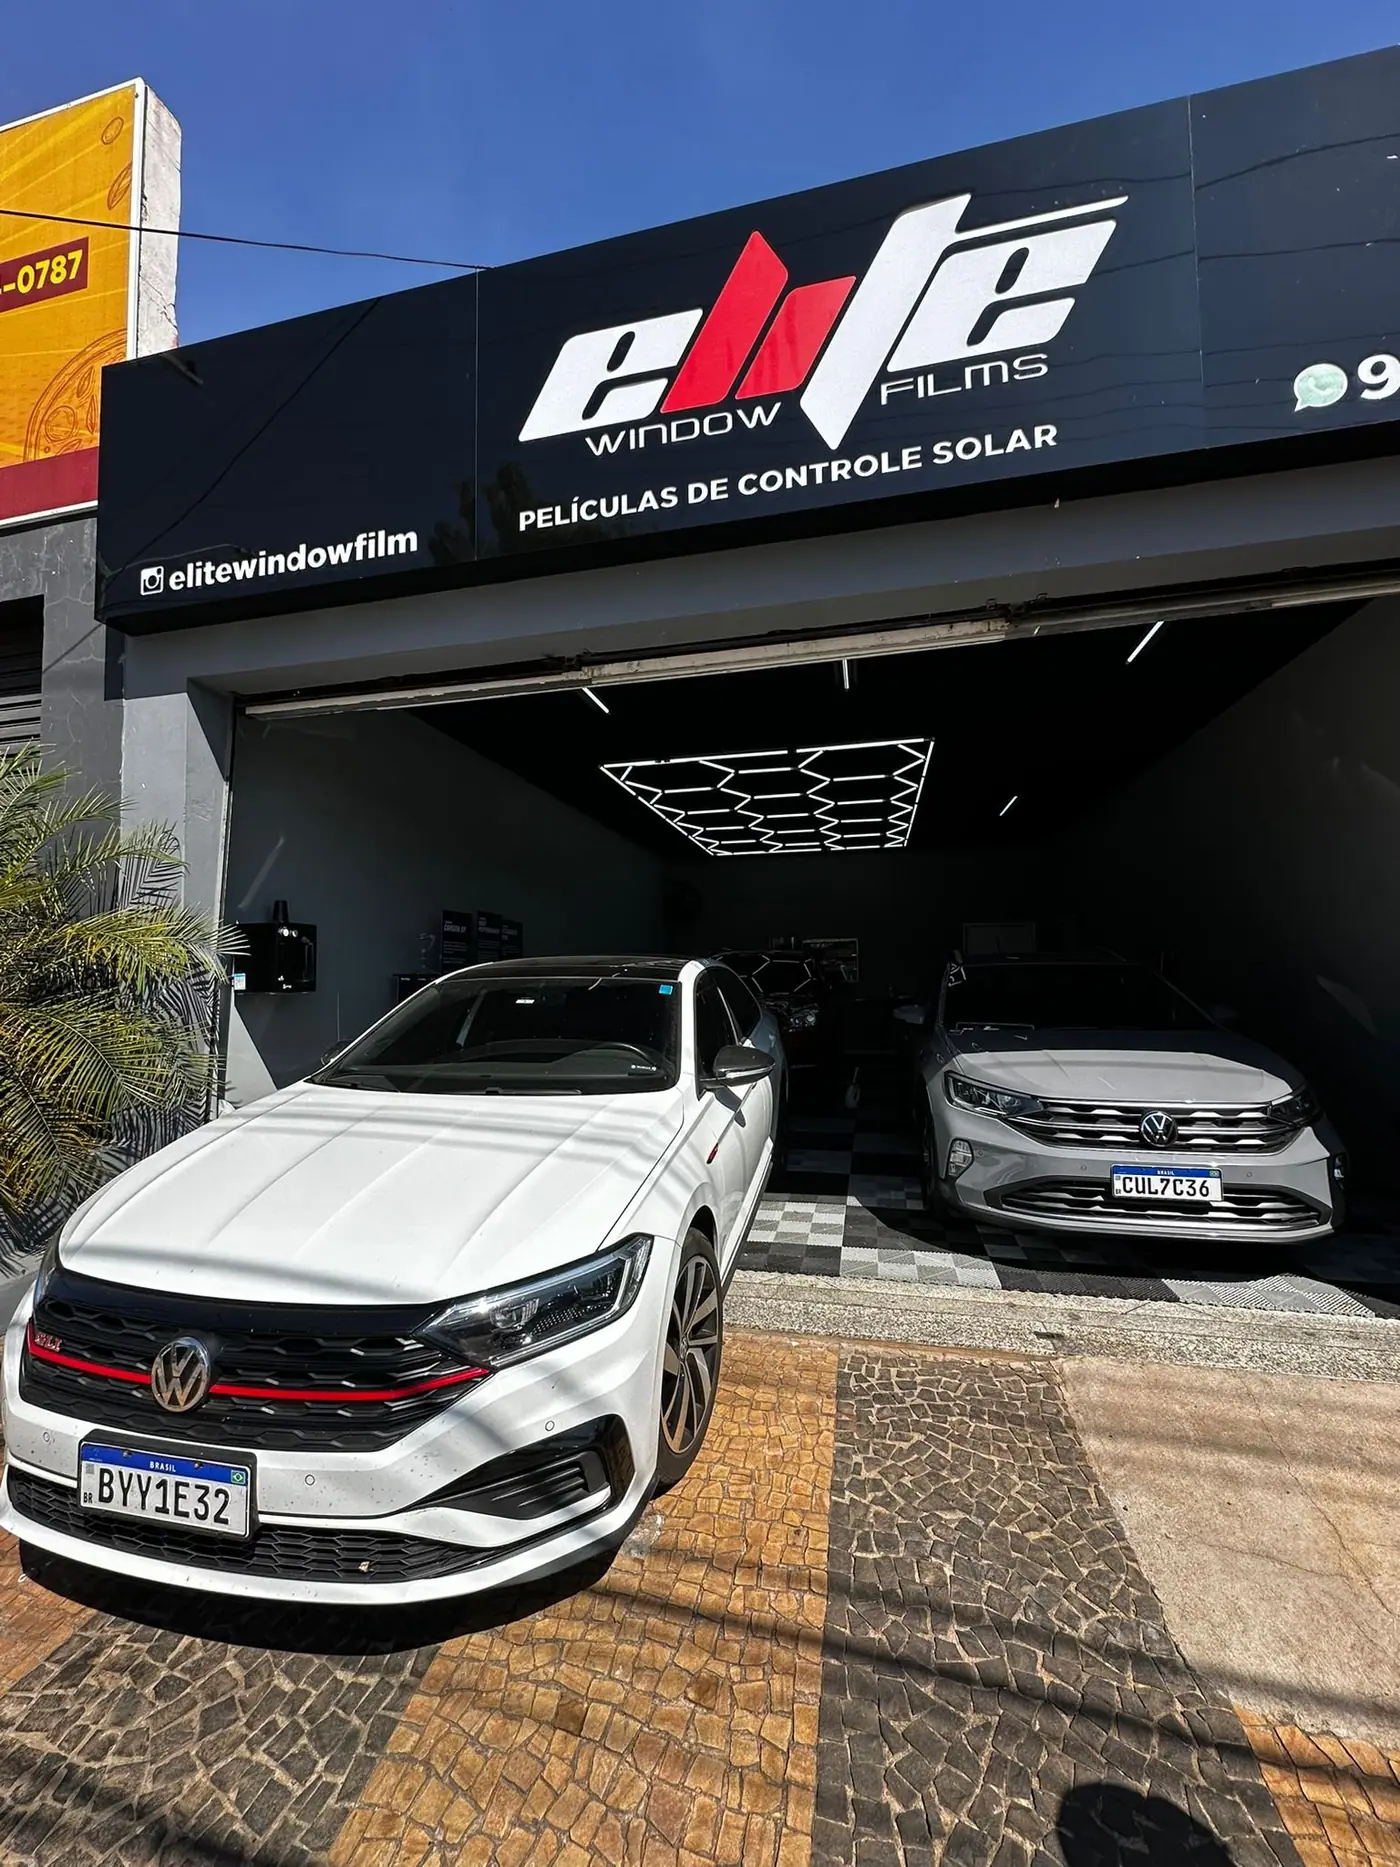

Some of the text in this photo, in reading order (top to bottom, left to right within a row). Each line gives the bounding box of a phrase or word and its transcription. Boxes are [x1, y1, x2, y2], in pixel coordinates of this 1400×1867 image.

[0, 249, 83, 293] -0787
[880, 351, 1049, 406] FILMS
[585, 401, 782, 456] WINDOW
[519, 424, 1058, 531] PELÍCULAS DE CONTROLE SOLAR
[168, 530, 418, 592] elitewindowfilm
[1122, 1176, 1209, 1197] CUL7C36
[149, 1460, 177, 1473] BRASIL
[83, 1491, 94, 1505] BR
[98, 1466, 230, 1525] BYY1E32
